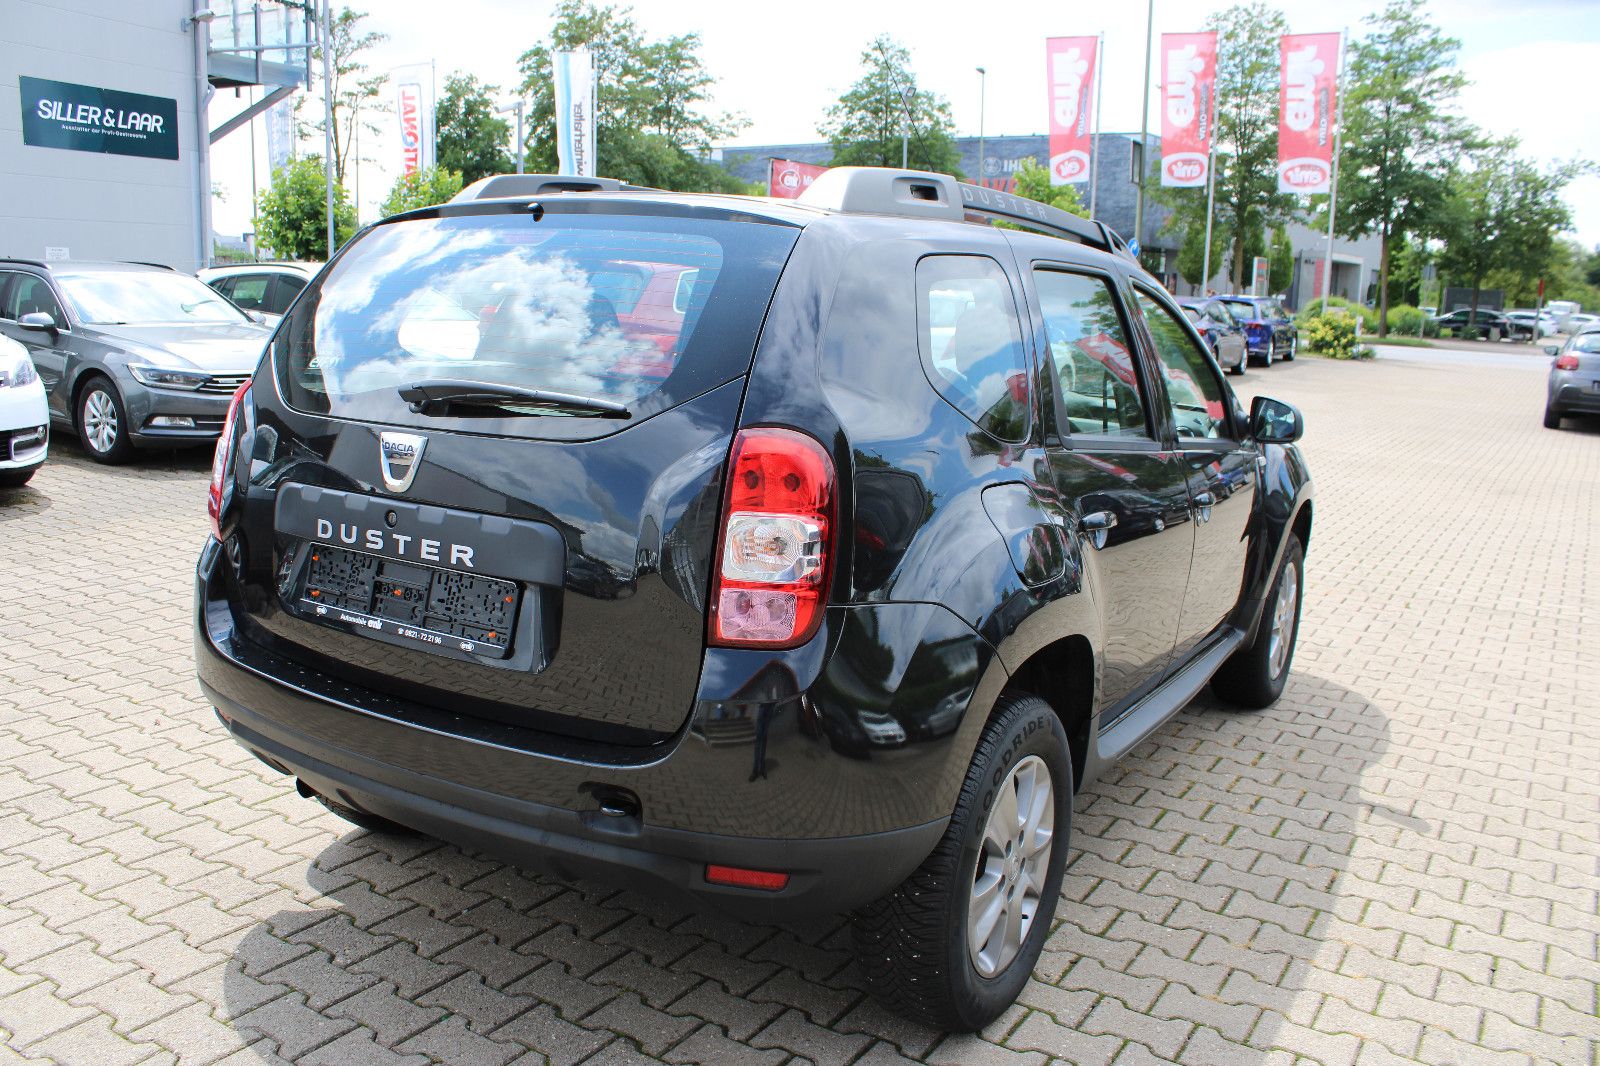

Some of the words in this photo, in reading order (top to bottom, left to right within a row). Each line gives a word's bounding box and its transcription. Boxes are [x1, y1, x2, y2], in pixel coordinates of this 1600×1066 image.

[37, 99, 101, 126] SILLER
[102, 108, 116, 128] &
[117, 110, 163, 134] LAAR
[962, 187, 1047, 220] DUSTER
[384, 441, 416, 452] DACIA
[317, 518, 475, 568] DUSTER
[976, 715, 1045, 836] GOODRIDE
